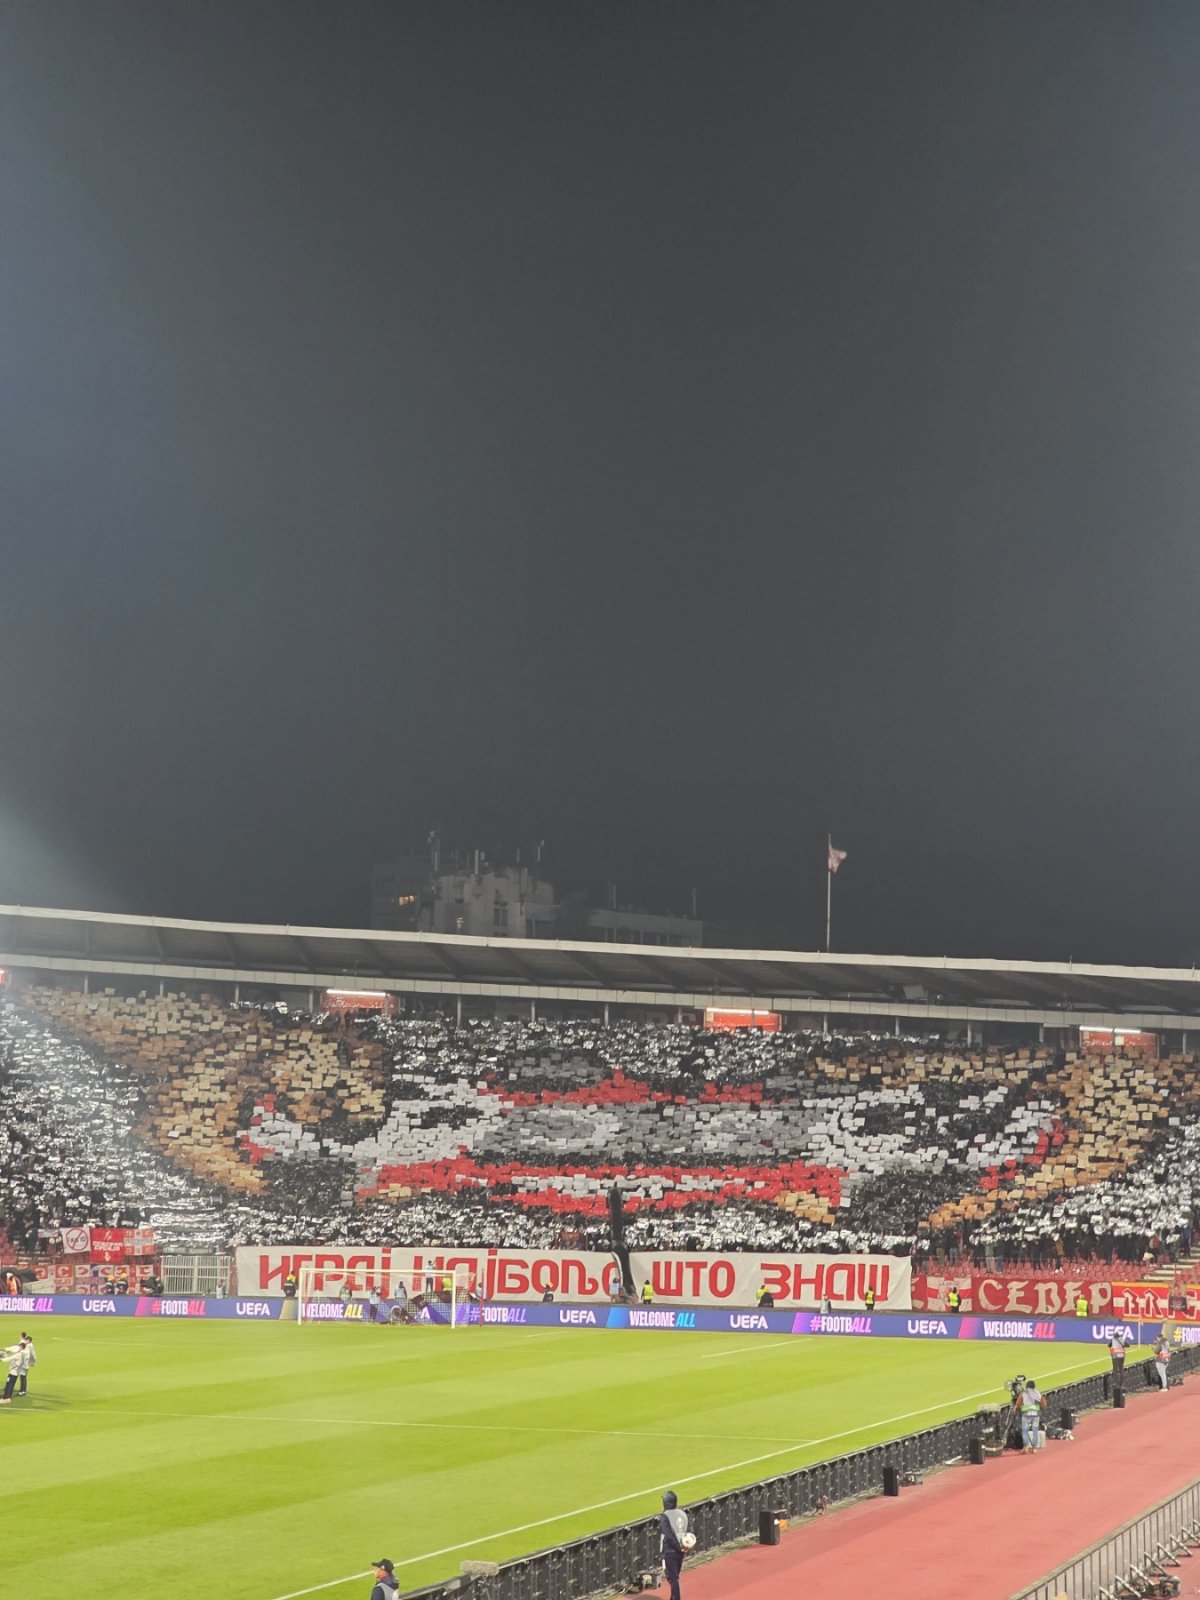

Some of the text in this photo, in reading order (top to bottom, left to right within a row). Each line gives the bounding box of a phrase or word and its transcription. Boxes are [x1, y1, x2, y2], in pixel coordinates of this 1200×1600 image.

[652, 1260, 736, 1298] ШТО
[760, 1263, 890, 1301] ЗНАШ
[36, 1298, 53, 1312] ALL
[82, 1299, 116, 1313] UEFA
[151, 1300, 206, 1315] #FOOTBALL
[236, 1302, 270, 1316] UEFA
[344, 1304, 363, 1318] ALL
[559, 1310, 596, 1324] UEFA
[629, 1311, 696, 1327] WELCOME ALL
[730, 1315, 768, 1329] UEFA
[809, 1316, 872, 1333] #FOOTBALL
[907, 1320, 948, 1335] UEFA
[984, 1321, 1055, 1338] WELCOME ALL
[1092, 1325, 1134, 1340] UEFA
